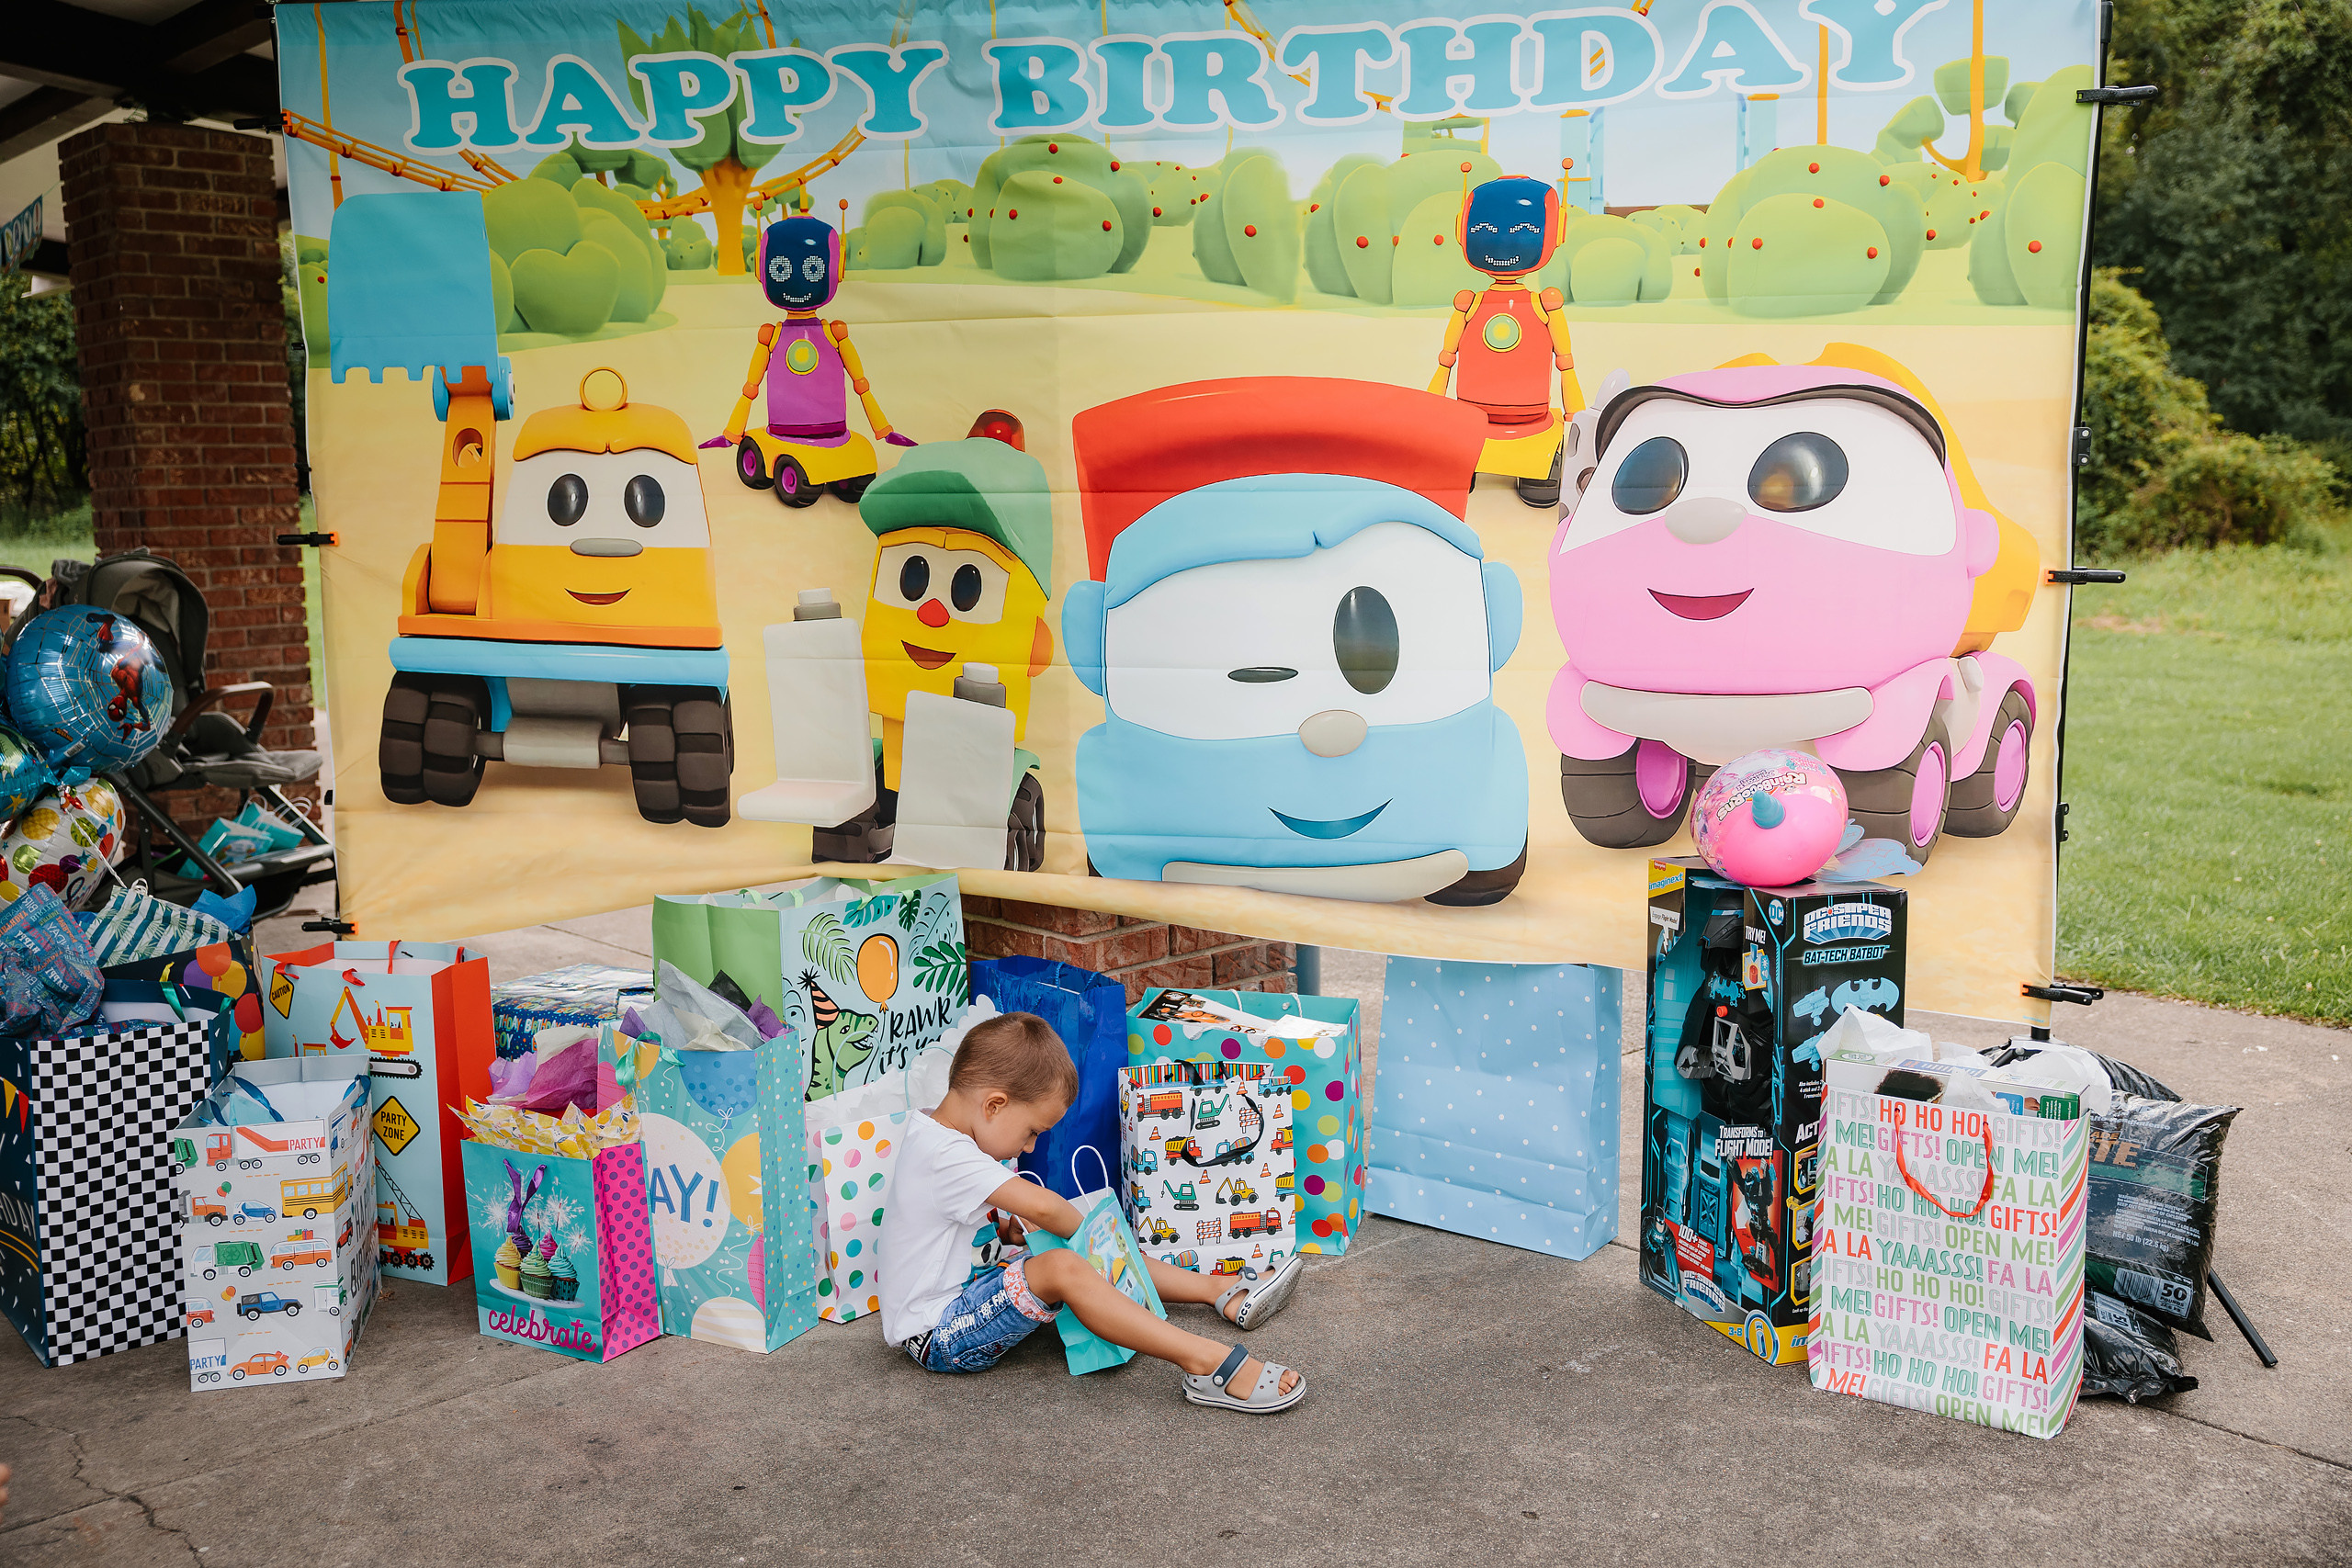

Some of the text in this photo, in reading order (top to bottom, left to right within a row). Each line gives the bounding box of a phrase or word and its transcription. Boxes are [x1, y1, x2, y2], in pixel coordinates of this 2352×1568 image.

[401, 0, 1948, 153] HAPPY BIRTHDAY
[1648, 872, 1684, 891] imaginext
[1769, 904, 1783, 921] DC
[1804, 903, 1892, 926] DC SUPER
[1804, 914, 1892, 939] FRIENDS
[1804, 945, 1886, 964] BAT-TECH BATBOT
[270, 983, 291, 1005] CAUTION
[889, 997, 953, 1043] RAWR
[879, 1045, 909, 1075] it's
[380, 1111, 407, 1127] PARTY
[1719, 1125, 1764, 1139] TRANSFORMS TO
[1880, 1099, 1906, 1125] HO
[1916, 1105, 1942, 1132] HO
[1993, 1116, 2061, 1149] GIFTS!
[288, 1136, 321, 1152] PARTY
[382, 1126, 405, 1142] ZONE
[1714, 1137, 1773, 1157] FLIGHT MODE!
[1836, 1119, 2059, 1179] ME! GIFTS! OPEN ME!
[1825, 1145, 1839, 1172] A
[1849, 1148, 1874, 1179] LA
[1992, 1174, 2018, 1203] FA
[2028, 1179, 2057, 1209] LA
[1877, 1184, 1905, 1213] HO
[1913, 1190, 1941, 1219] HO
[1990, 1204, 2058, 1238] GIFTS!
[1834, 1202, 2055, 1268] ME! GIFTS! OPEN ME!
[2127, 1234, 2134, 1242] 50
[1822, 1229, 2053, 1297] A LA YAAASSS! FA LA
[1876, 1267, 1904, 1292] HO
[1913, 1273, 1940, 1300] HO
[1950, 1280, 1984, 1309] HO!
[1988, 1288, 2053, 1327] GIFTS!
[2161, 1282, 2188, 1302] 50
[487, 1304, 598, 1354] celebrate
[1727, 1325, 1744, 1337] 3-8
[1831, 1286, 2051, 1357] ME! GIFTS! OPEN ME!
[1820, 1312, 2049, 1384] A LA YAAASSS! FA LA
[189, 1355, 221, 1371] PARTY
[1873, 1349, 1902, 1379] HO
[1908, 1357, 1937, 1388] HO
[1941, 1365, 1979, 1399] HO!
[1982, 1375, 2048, 1414] GIFTS!
[1826, 1368, 1867, 1398] ME!
[1936, 1393, 1992, 1428] OPEN
